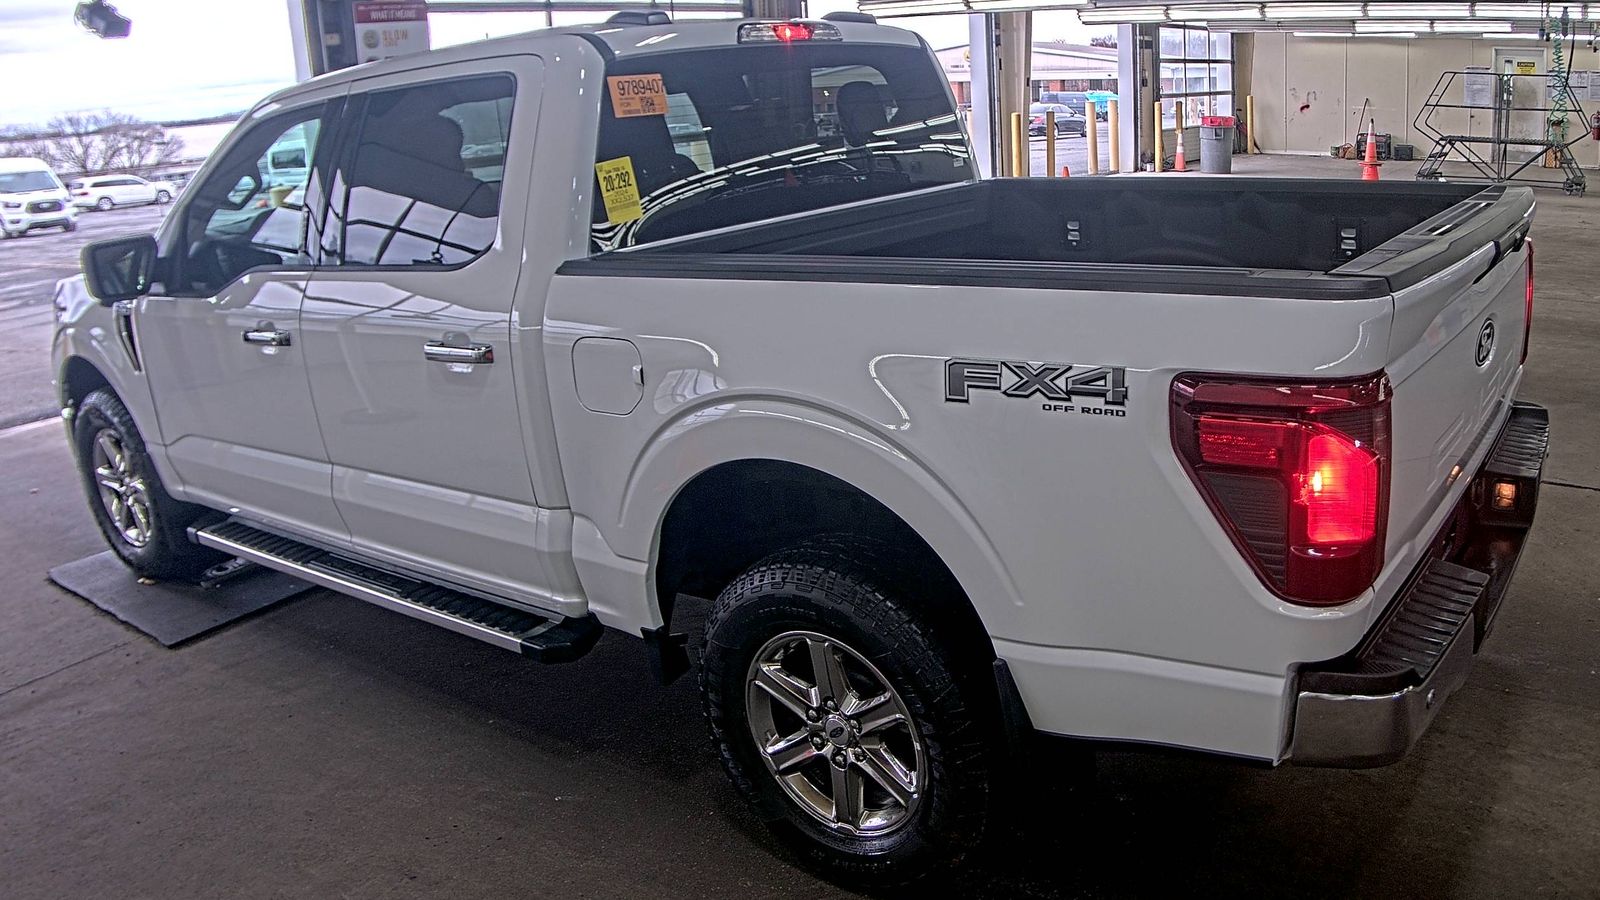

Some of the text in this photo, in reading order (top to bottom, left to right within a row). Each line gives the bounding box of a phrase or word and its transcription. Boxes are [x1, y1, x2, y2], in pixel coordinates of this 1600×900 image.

[382, 30, 408, 41] SLOW
[617, 79, 664, 96] 9789407
[945, 356, 1128, 407] FX4
[1042, 403, 1127, 417] OFF ROAD
